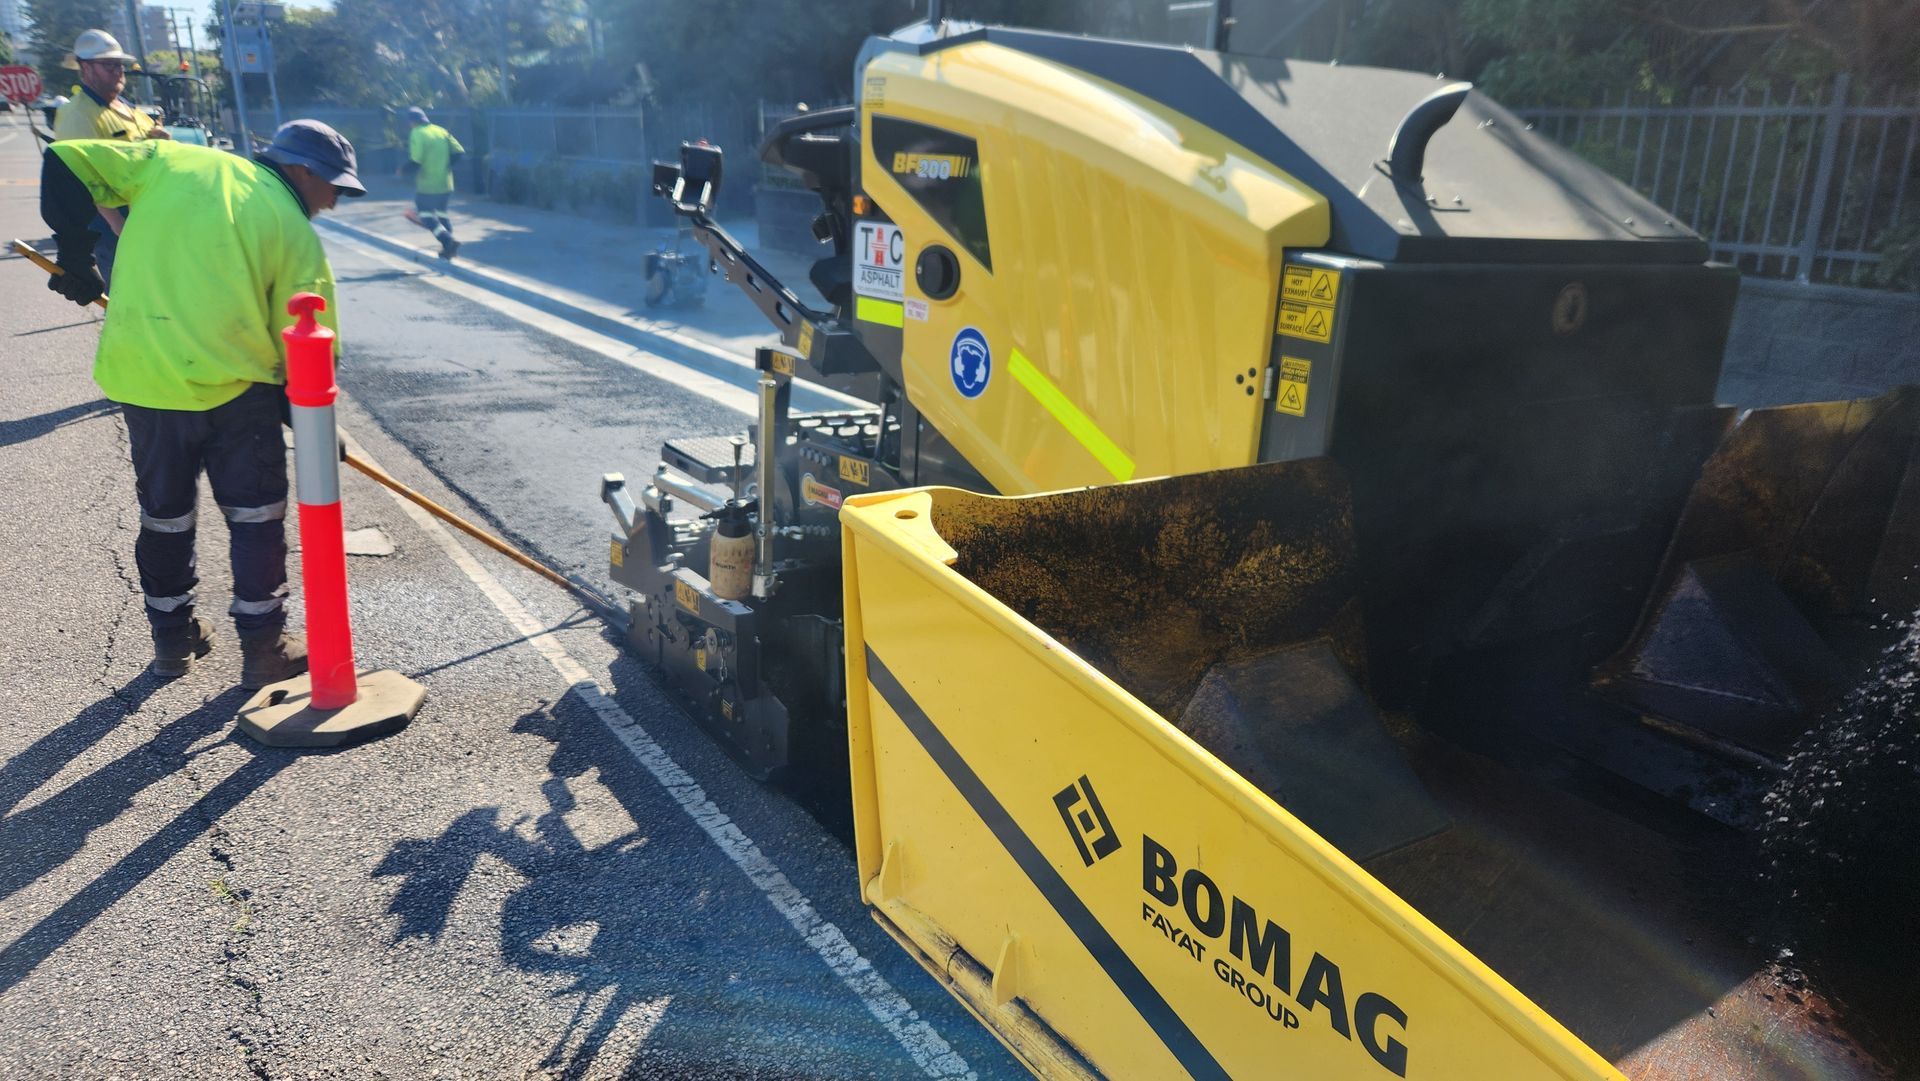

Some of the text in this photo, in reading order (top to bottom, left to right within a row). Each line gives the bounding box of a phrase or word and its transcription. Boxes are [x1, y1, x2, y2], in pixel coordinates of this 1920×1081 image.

[0, 73, 38, 95] STOP
[860, 270, 900, 289] ASPHALT
[1284, 287, 1307, 297] EXHAUST
[1280, 322, 1303, 333] SURFACE
[1287, 314, 1298, 322] HOT
[1143, 834, 1408, 1078] BOMAG
[1143, 901, 1300, 1030] FAYAT GROUP
